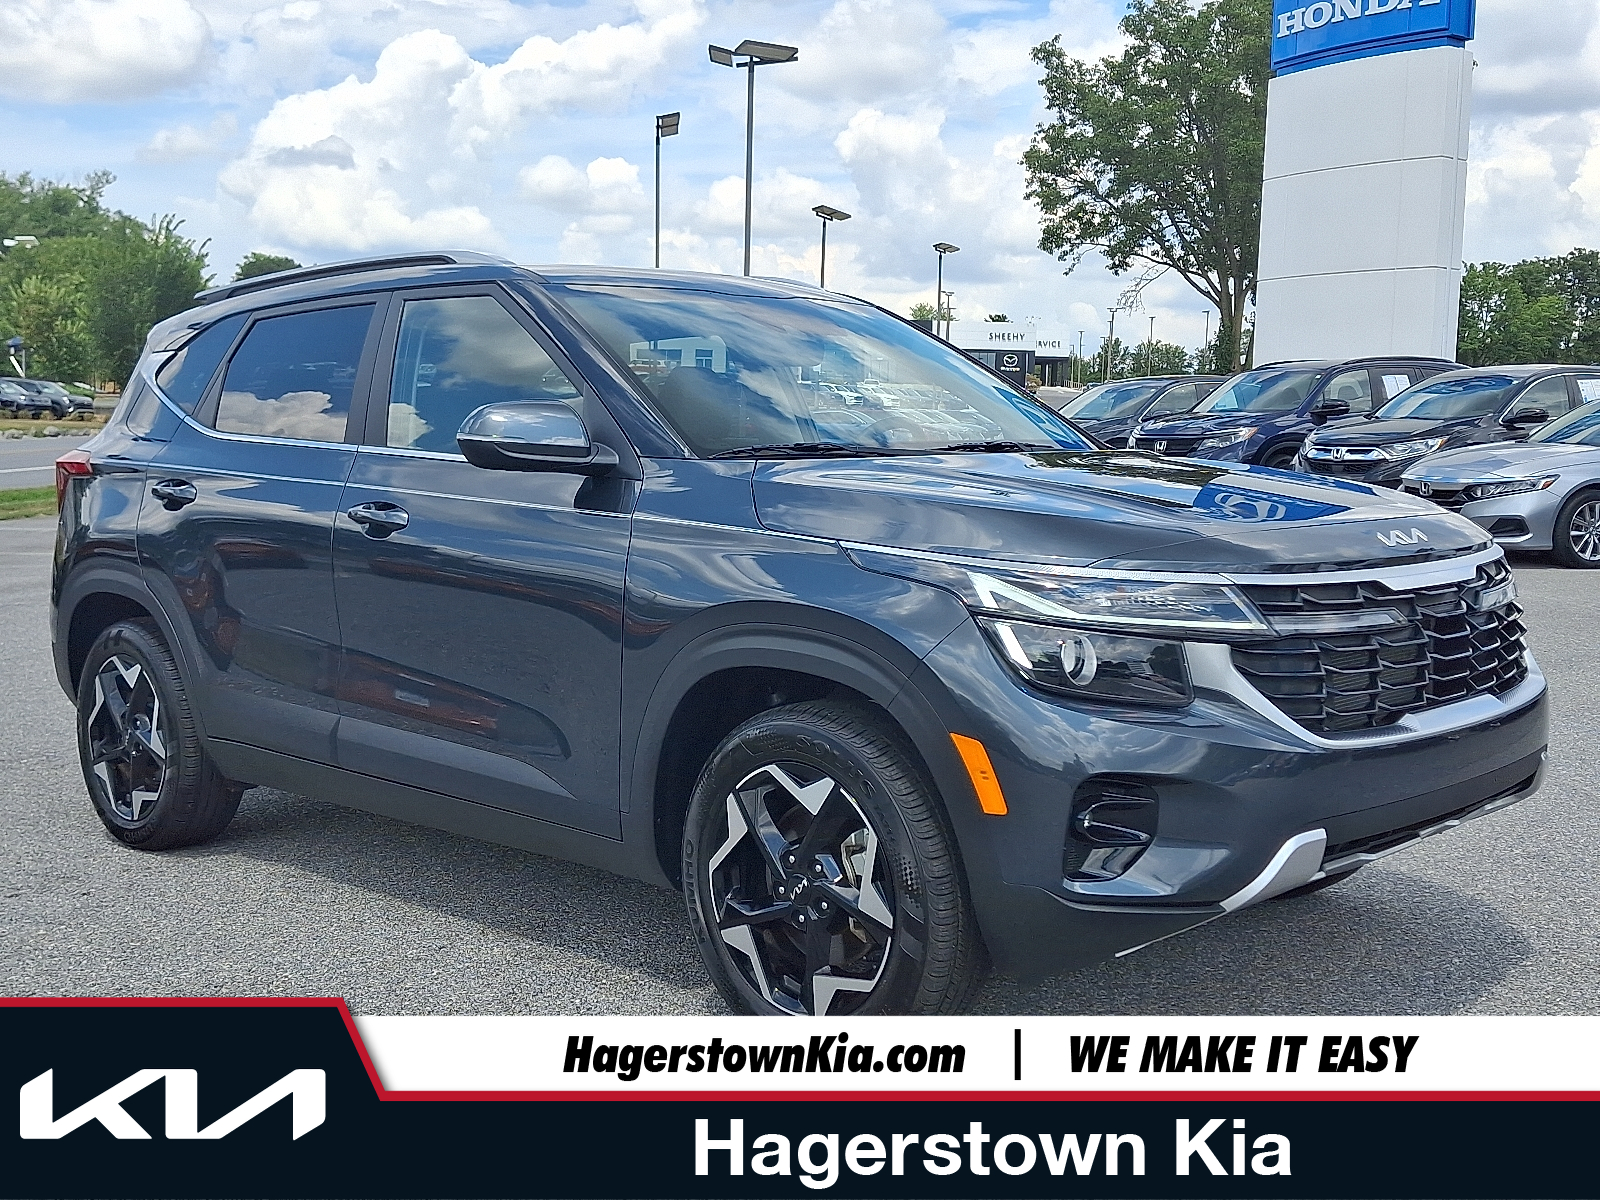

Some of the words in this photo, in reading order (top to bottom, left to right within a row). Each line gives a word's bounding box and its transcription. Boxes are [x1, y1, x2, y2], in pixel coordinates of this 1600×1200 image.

[1276, 0, 1441, 38] HOND
[988, 332, 1025, 341] SHEEHY
[1035, 340, 1061, 349] RVICE
